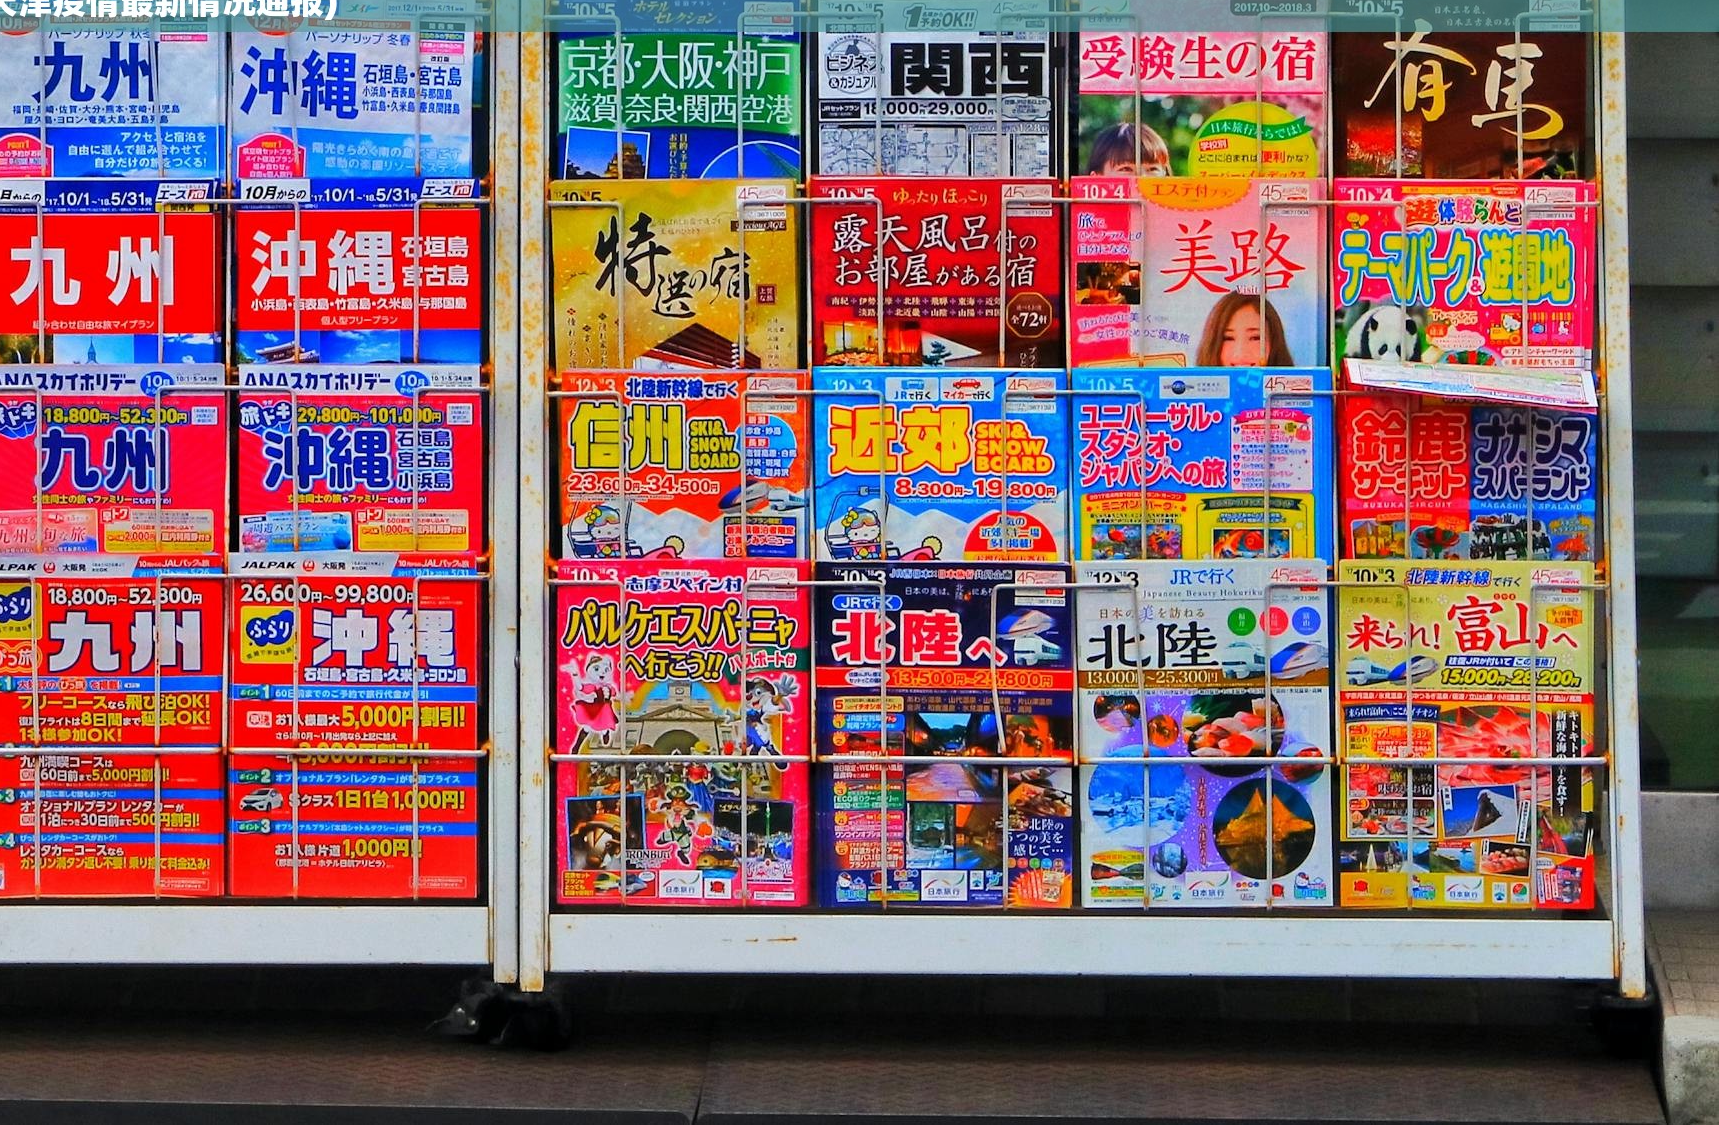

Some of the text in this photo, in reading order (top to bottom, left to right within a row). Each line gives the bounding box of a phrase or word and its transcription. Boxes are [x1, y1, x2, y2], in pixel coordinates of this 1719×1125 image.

[32, 41, 159, 103] 九州
[240, 46, 359, 120] 沖縄
[563, 39, 792, 91] 京都・大阪・神戸
[889, 42, 1046, 97] 関西
[1082, 35, 1317, 81] 受験生の宿
[1363, 17, 1564, 141] 有馬
[1150, 182, 1236, 199] エステ付プラン
[832, 213, 1037, 255] 露天風呂付の
[1160, 220, 1307, 295] 美路
[10, 235, 174, 307] 九州
[251, 229, 396, 296] 沖縄
[835, 253, 1035, 288] お部屋がある宿
[321, 314, 398, 326] 個人型フリープラン
[625, 378, 738, 398] 北陸新幹線で行く
[40, 428, 170, 492] 九州
[264, 427, 392, 491] 沖縄
[572, 404, 683, 472] 信州
[689, 453, 740, 470] BOARD
[690, 437, 736, 454] SNOW
[829, 404, 972, 476] 近郊
[1353, 409, 1466, 468] 鈴鹿
[62, 561, 86, 573] 大阪発
[625, 577, 743, 594] 志摩スペイン村
[1170, 567, 1235, 585] JRで行く
[1405, 568, 1521, 588] 北陸新幹線で行く
[48, 610, 201, 673] 九州
[312, 609, 456, 667] 沖縄
[564, 602, 798, 648] パルケエスパーニャ
[832, 611, 1008, 666] 北陸へ
[1087, 623, 1220, 671] 北陸
[927, 884, 960, 896] 日本旅行
[1191, 888, 1225, 900] 日本旅行
